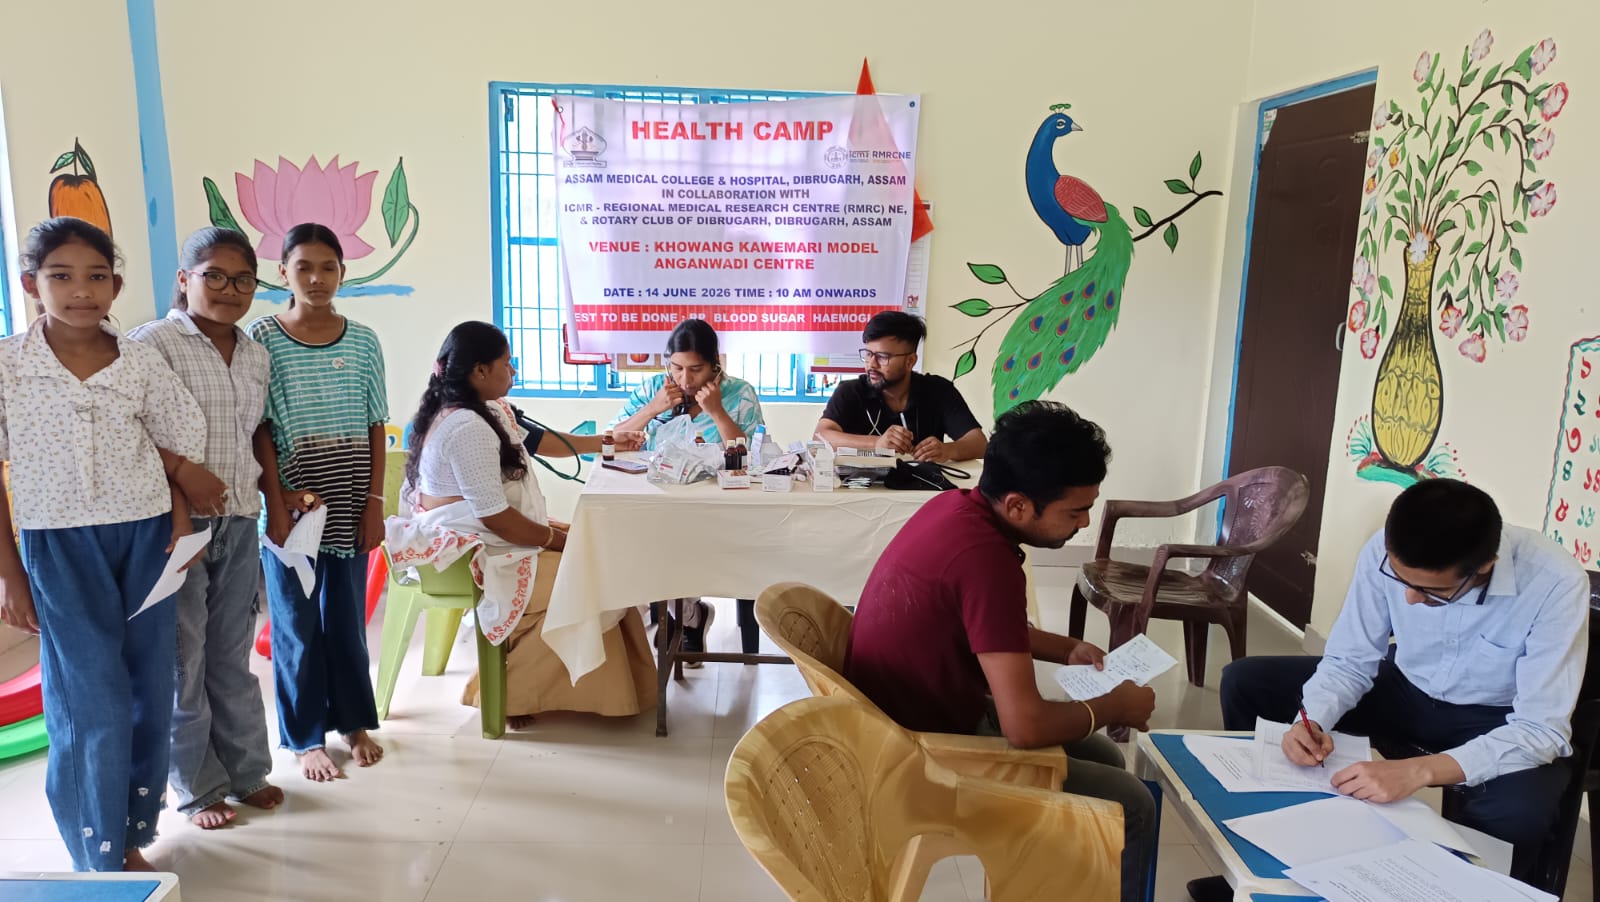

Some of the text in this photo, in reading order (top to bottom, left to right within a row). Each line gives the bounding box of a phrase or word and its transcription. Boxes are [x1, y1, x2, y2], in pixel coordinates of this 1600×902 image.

[632, 121, 833, 140] HEALTH CAMP
[872, 151, 911, 159] RMRCNE
[565, 174, 906, 186] ASSAM MEDICAL COLLEGE & HOSPITAL, DIBRUGARH, ASSAM
[662, 189, 810, 199] IN COLLABORATION WITH
[564, 203, 593, 212] ICMR
[603, 203, 664, 212] REGIONAL
[668, 203, 722, 212] MEDICAL
[725, 204, 789, 212] RESEARCH
[793, 204, 840, 213] CENTRE
[843, 204, 885, 214] (RMRC)
[888, 205, 907, 215] NE,
[580, 216, 892, 227] & ROTARY CLUB OF DIBRUGARH, DIBRUGARH, ASSAM
[589, 242, 640, 252] VENUE
[654, 241, 734, 253] KHOWANG
[739, 242, 822, 253] KAWEMARI
[827, 242, 879, 253] MODEL
[654, 258, 815, 269] ANGANWADI CENTRE
[604, 288, 634, 297] DATE
[645, 288, 658, 297] 14
[663, 288, 696, 297] JUNE
[701, 288, 731, 297] 2026
[735, 288, 765, 297] TIME
[776, 288, 789, 297] 10
[793, 288, 812, 297] AM
[815, 288, 877, 297] ONWARDS
[574, 313, 597, 322] EST
[601, 313, 617, 322] TO
[621, 313, 638, 322] BE
[642, 313, 678, 322] DONE
[714, 313, 757, 322] BLOOD
[761, 313, 806, 323] SUGAR
[1580, 356, 1591, 379] ১
[1574, 389, 1586, 416] ২
[1565, 427, 1582, 453] ৩
